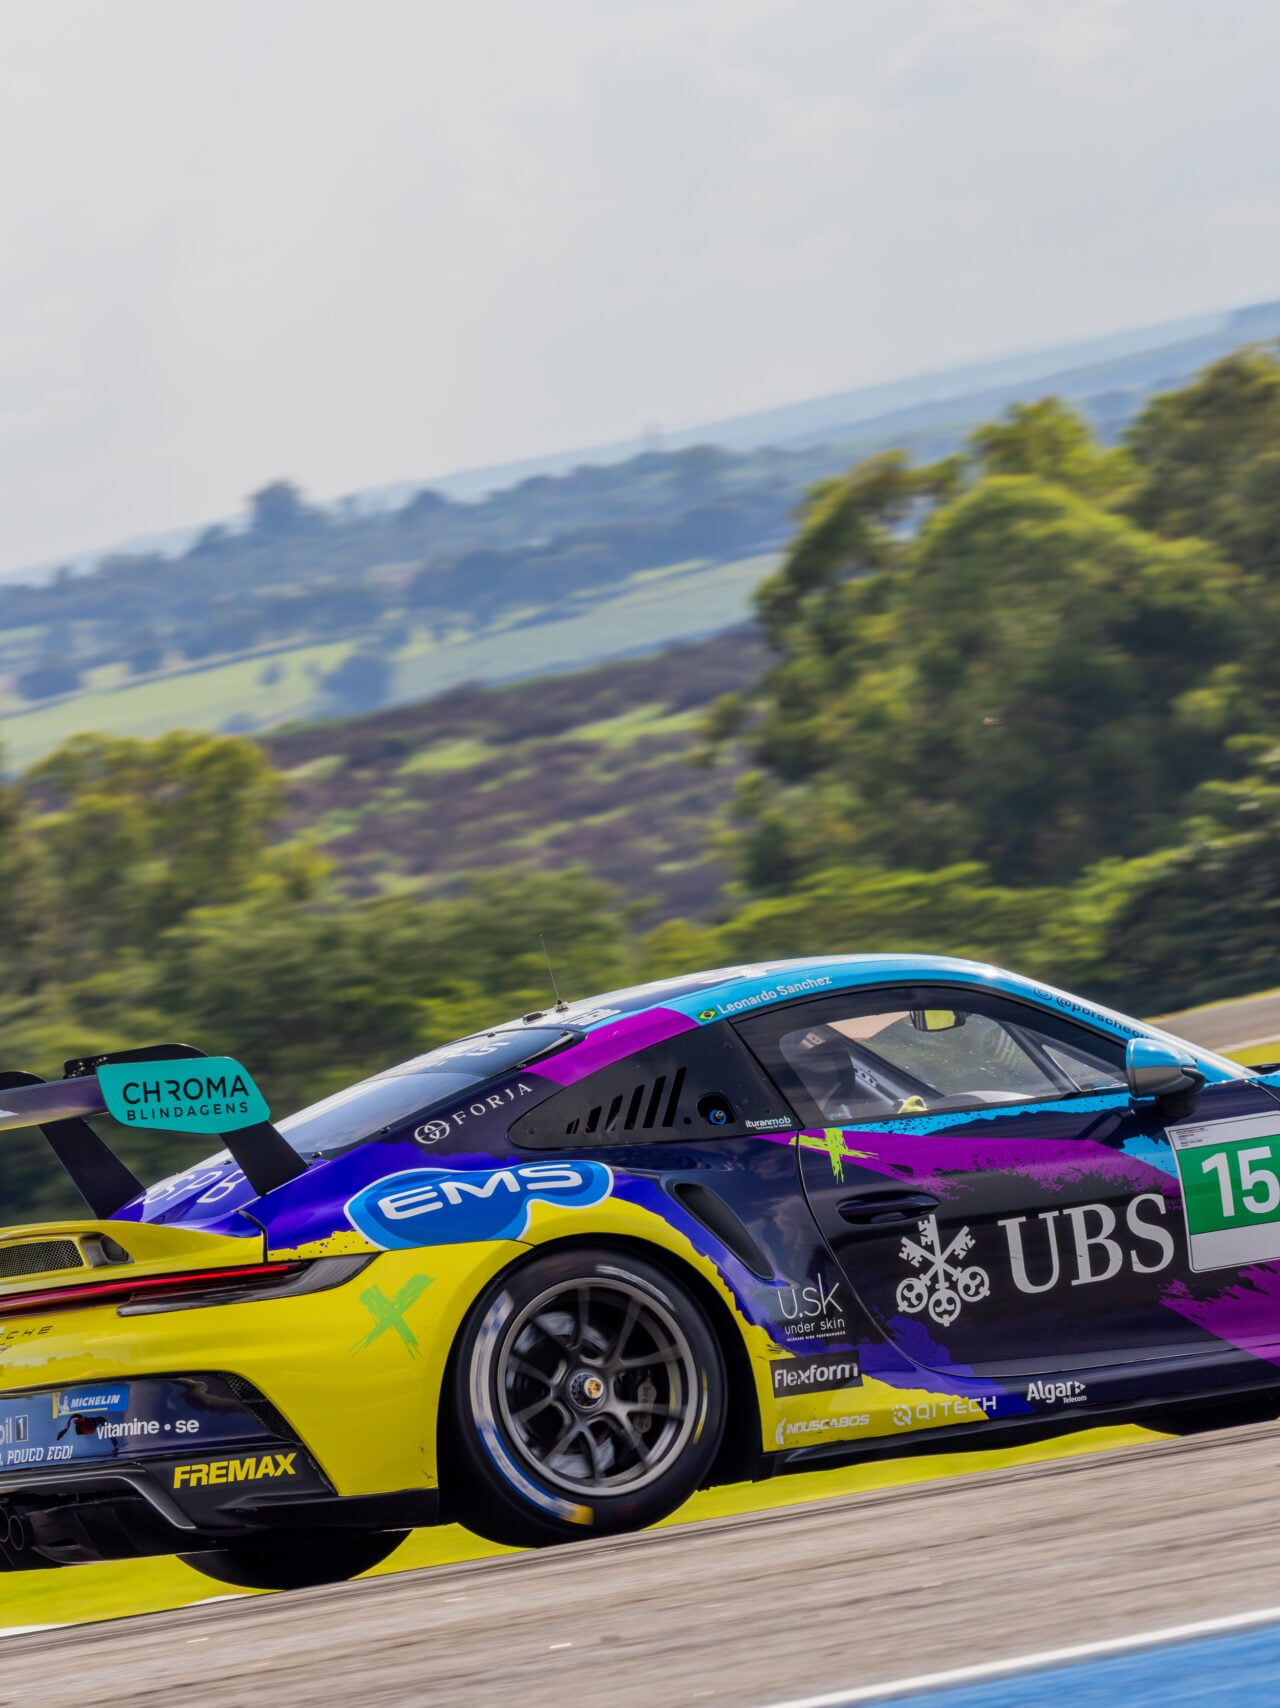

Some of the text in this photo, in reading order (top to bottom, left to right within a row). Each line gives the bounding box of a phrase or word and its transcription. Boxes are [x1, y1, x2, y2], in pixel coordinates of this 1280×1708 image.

[717, 976, 833, 1015] Leonardo Sanchez
[122, 1074, 250, 1105] CHROMA
[127, 1102, 249, 1121] BLINDAGENS
[451, 1082, 533, 1126] FORJA
[377, 1163, 583, 1220] EMS
[998, 1193, 1176, 1294] UBS
[784, 1317, 845, 1335] under skin
[774, 1362, 859, 1389] Flexform
[71, 1394, 120, 1409] MICHELIN
[1026, 1380, 1074, 1404] Algar
[1063, 1395, 1088, 1404] Telecom
[97, 1418, 200, 1440] vitamine se
[173, 1453, 297, 1489] FREMAX
